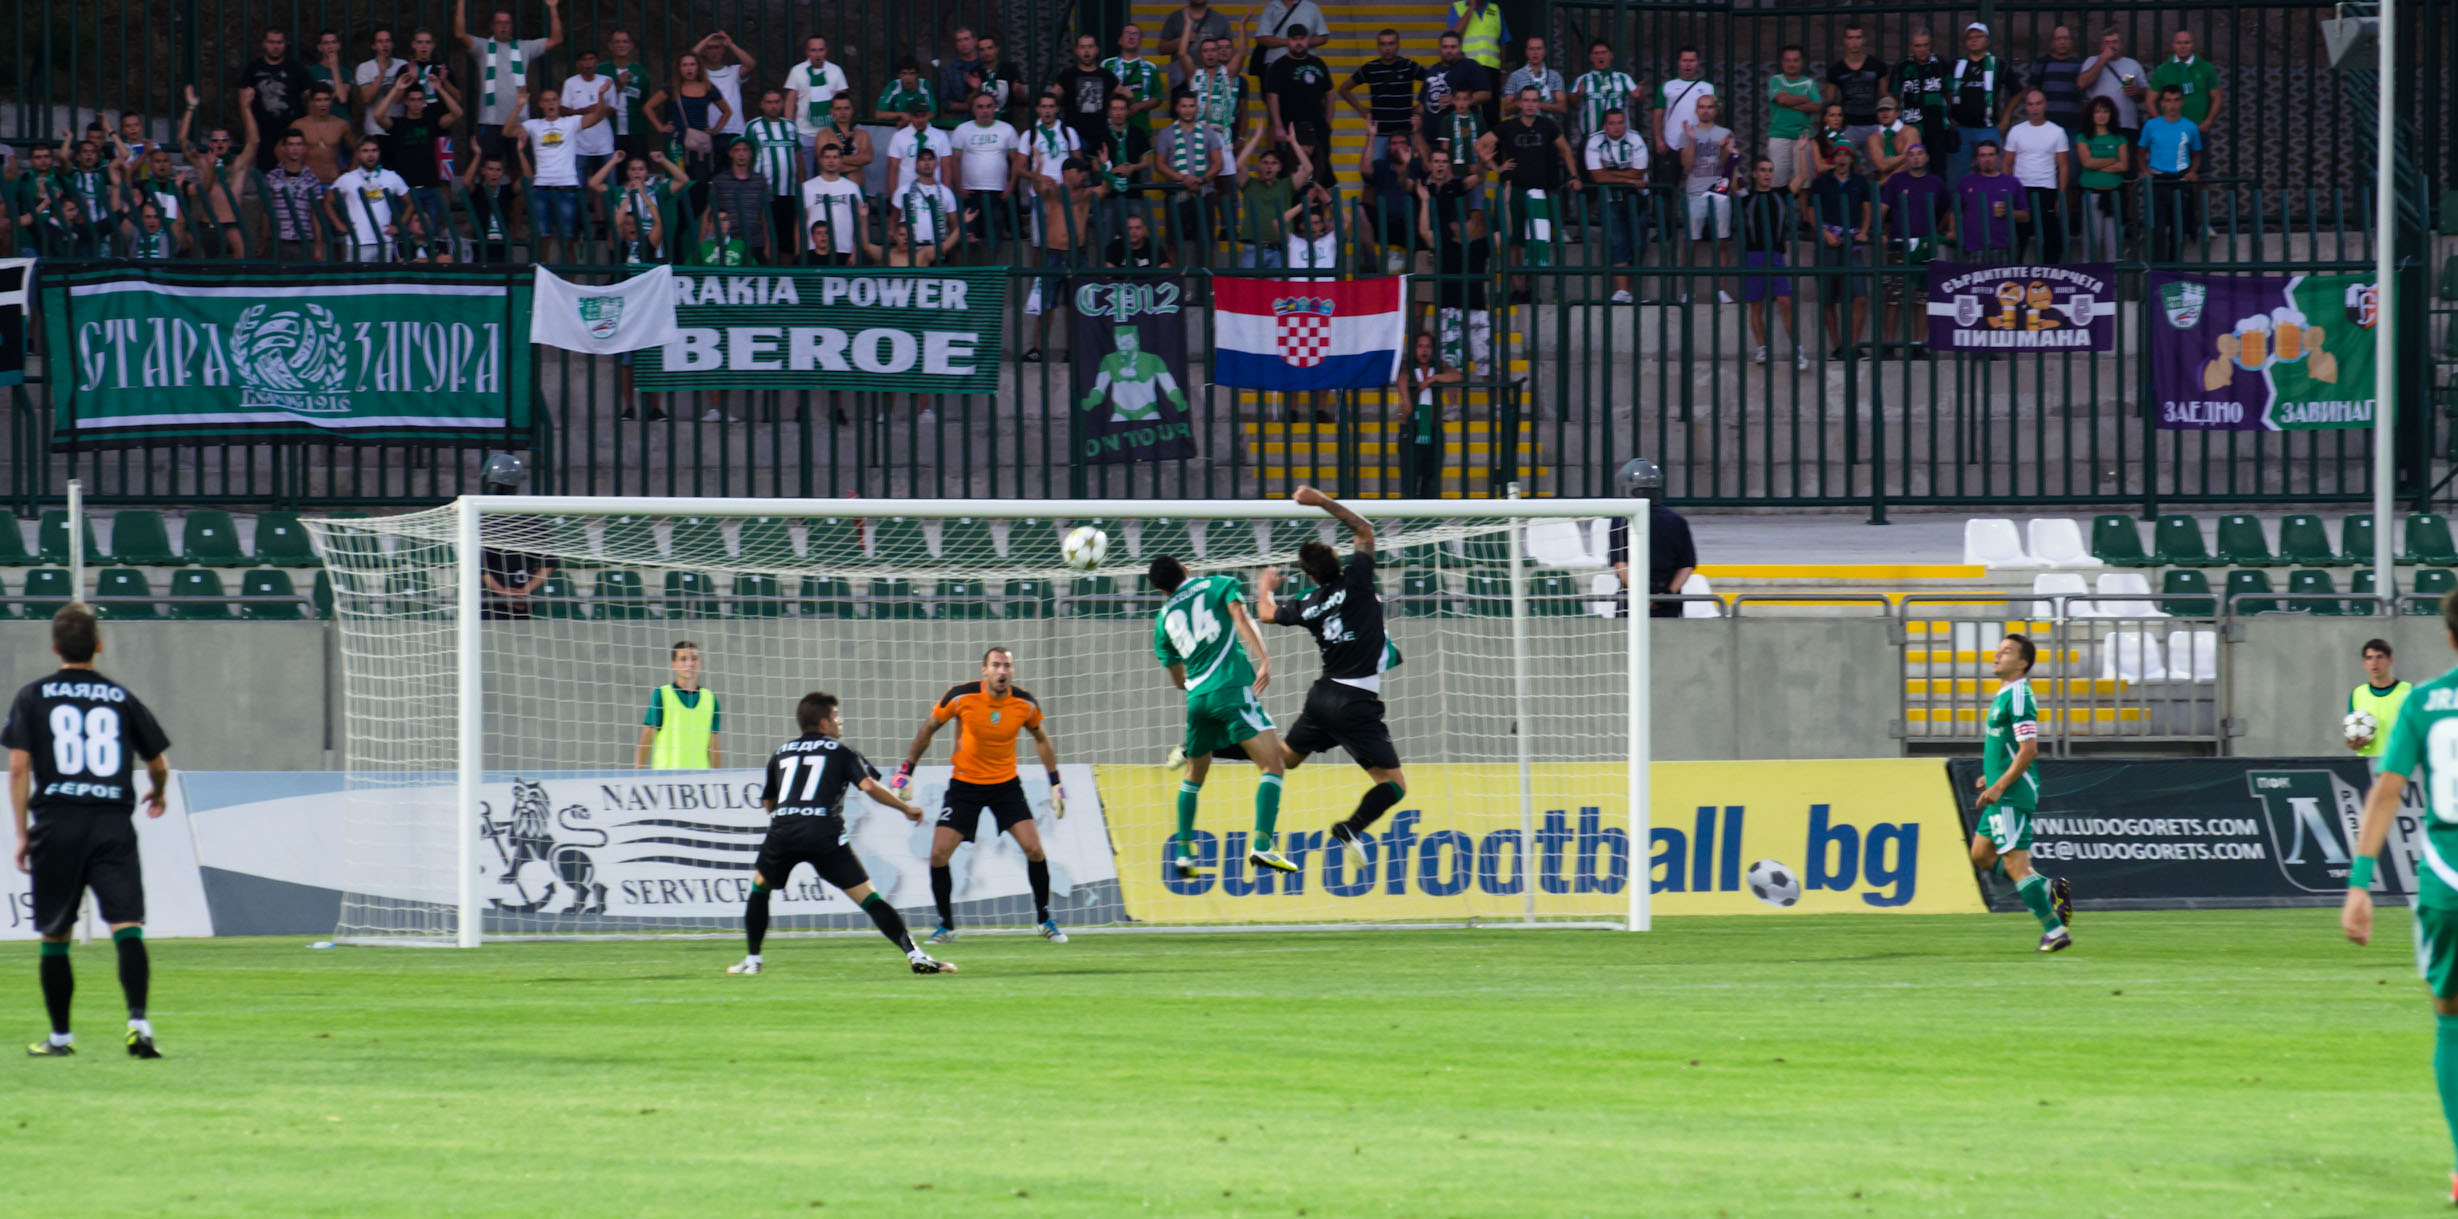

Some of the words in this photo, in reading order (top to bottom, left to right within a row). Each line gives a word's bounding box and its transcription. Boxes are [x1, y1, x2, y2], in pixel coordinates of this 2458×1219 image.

[672, 275, 799, 305] RAKIA
[822, 276, 968, 310] POWER
[1941, 267, 2029, 294] СЪРДИТИТЕ
[2030, 267, 2104, 294] СТАРЧЕТА
[662, 326, 980, 375] BEROE
[1952, 328, 2092, 348] ПИШМАНА
[78, 317, 230, 392] СТАРА
[352, 321, 499, 393] ЗАГОРА
[2163, 400, 2245, 427] ЗАЕДНО
[2279, 399, 2376, 424] ЗАВИНАГ
[1085, 432, 1121, 458] ON
[1122, 421, 1192, 448] TOUR
[41, 682, 126, 703] КАЯДО
[49, 703, 121, 778] 88
[775, 739, 841, 755] ПЕДРО
[777, 755, 827, 805] 11
[602, 783, 764, 811] NAVIBULG
[2029, 841, 2266, 861] CE@LUDOGORETS.COM
